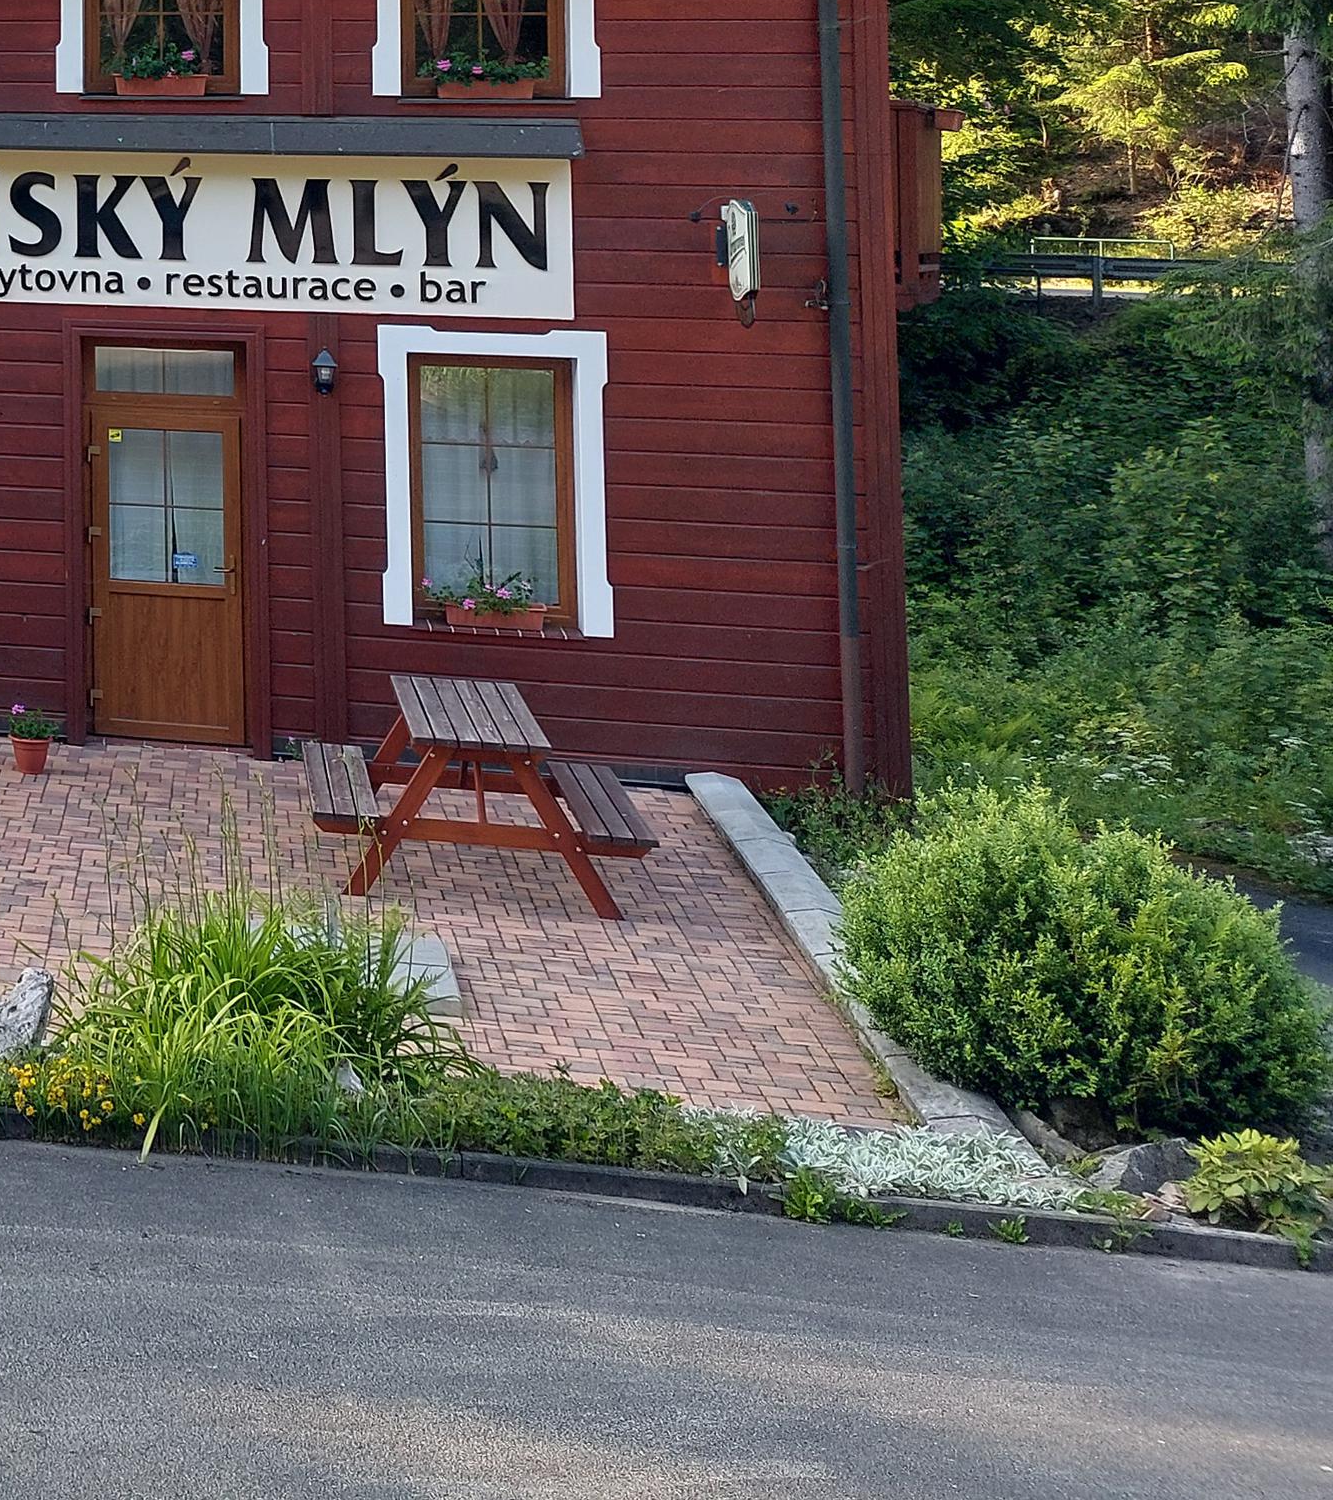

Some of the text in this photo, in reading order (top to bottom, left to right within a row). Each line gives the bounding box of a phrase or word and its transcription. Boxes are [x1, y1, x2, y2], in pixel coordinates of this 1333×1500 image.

[245, 163, 551, 272] MLÝN
[165, 269, 377, 302] restaurace
[419, 270, 487, 304] bar
